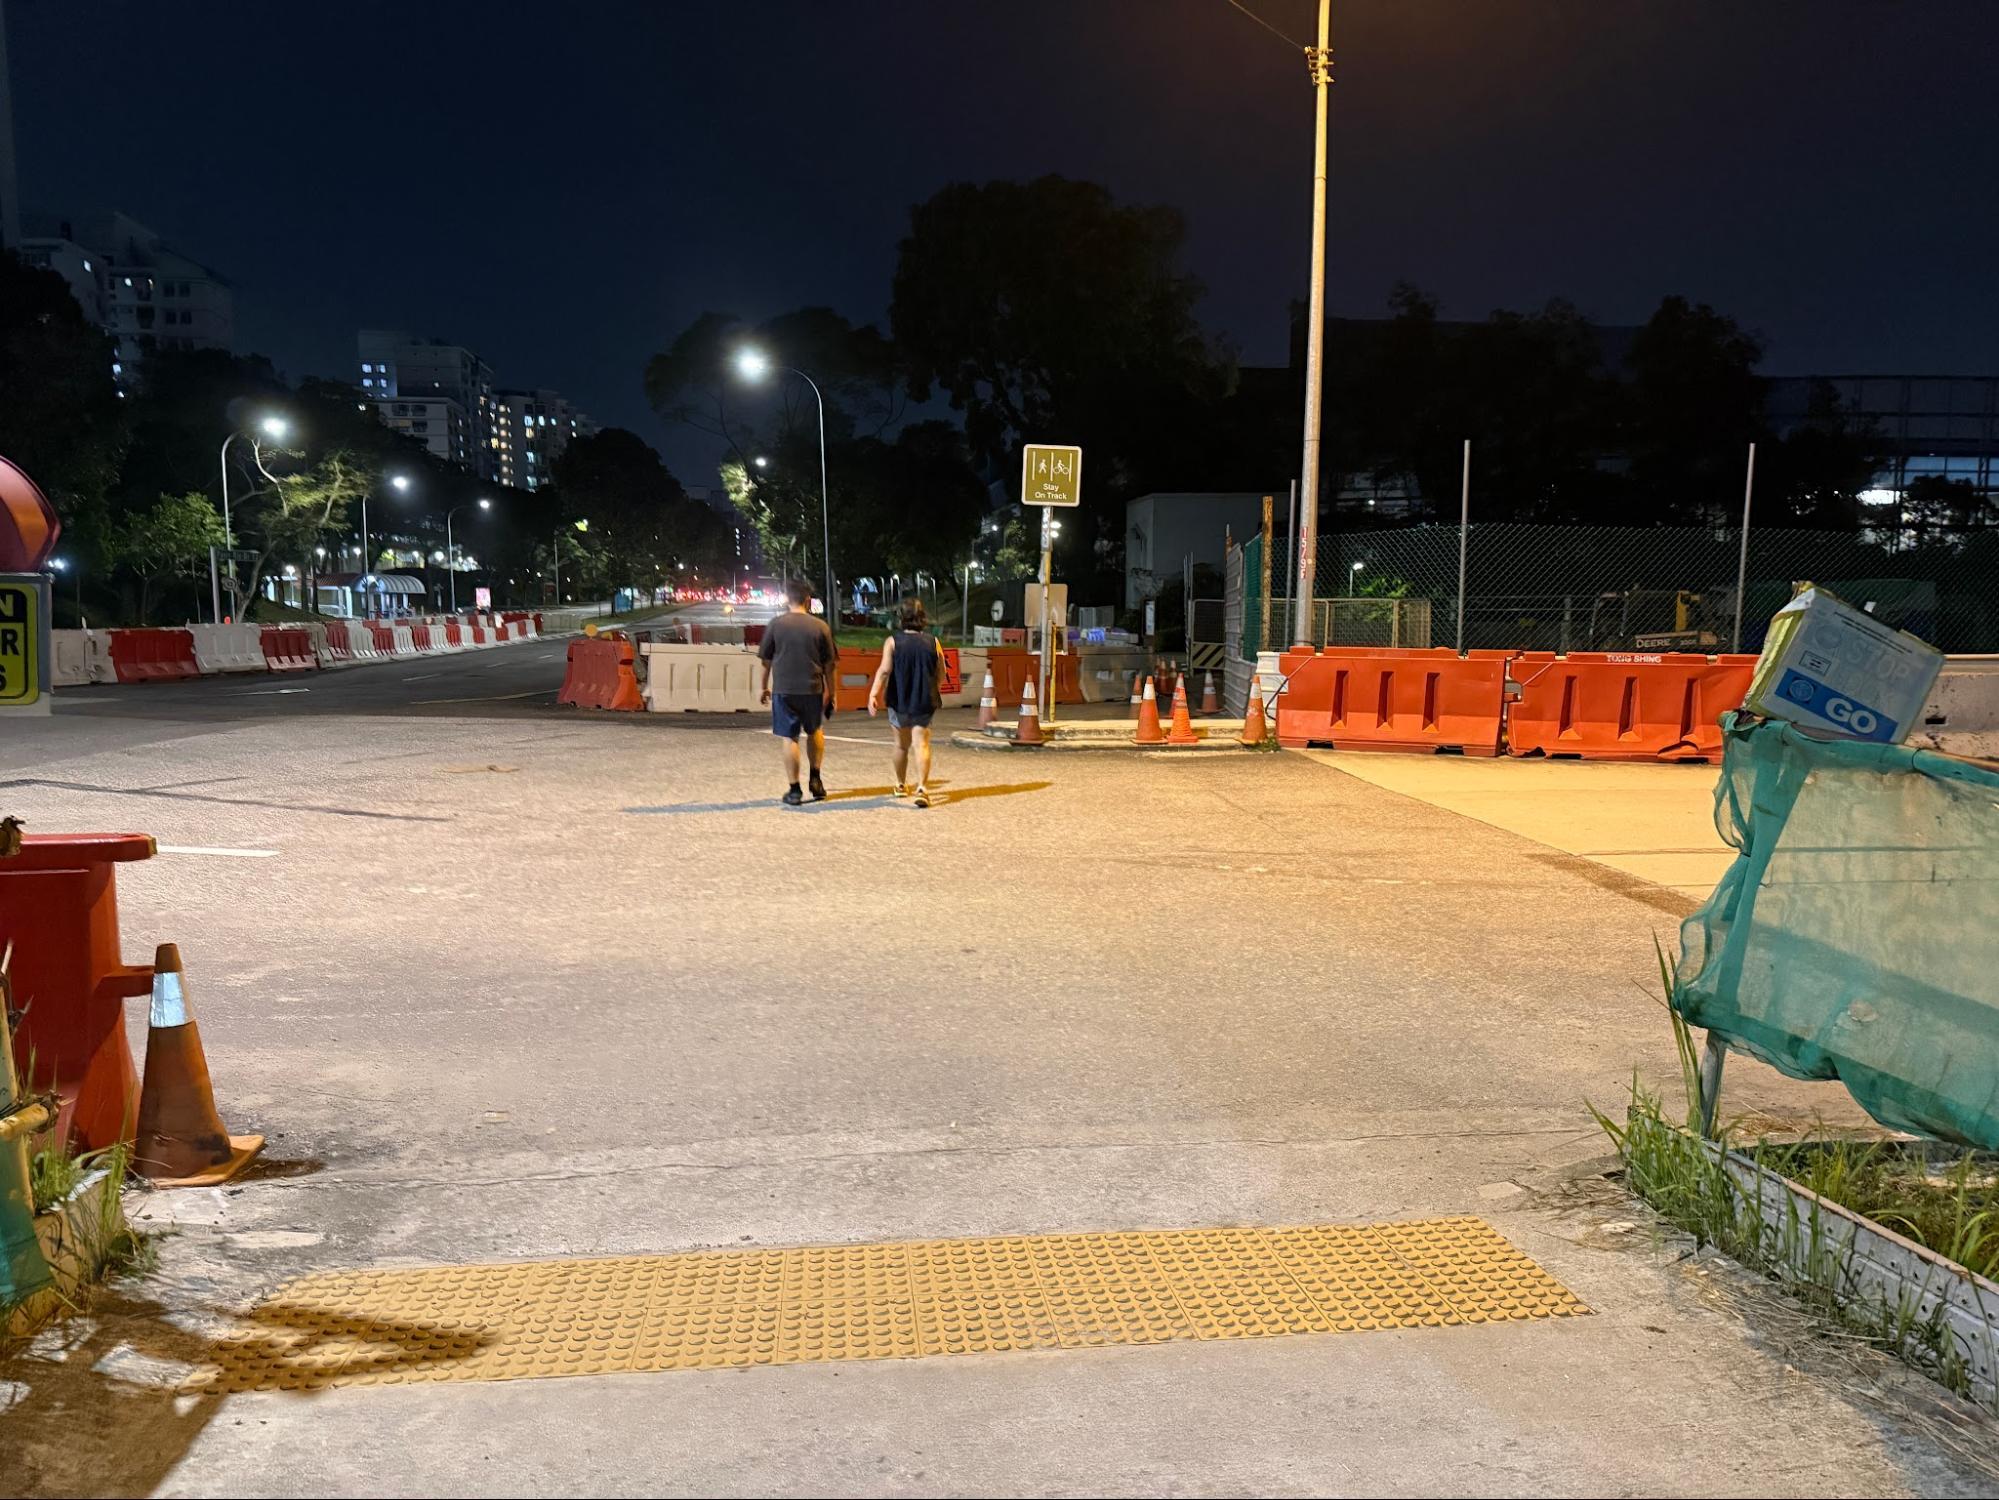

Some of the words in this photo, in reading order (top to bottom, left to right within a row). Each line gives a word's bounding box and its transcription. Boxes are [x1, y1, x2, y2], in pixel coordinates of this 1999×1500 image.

[1043, 483, 1059, 492] Stay
[1035, 491, 1045, 499] On
[1047, 492, 1067, 500] Track
[1636, 638, 1671, 648] DEERE
[1633, 655, 1662, 664] SHING
[1825, 697, 1877, 734] GO
